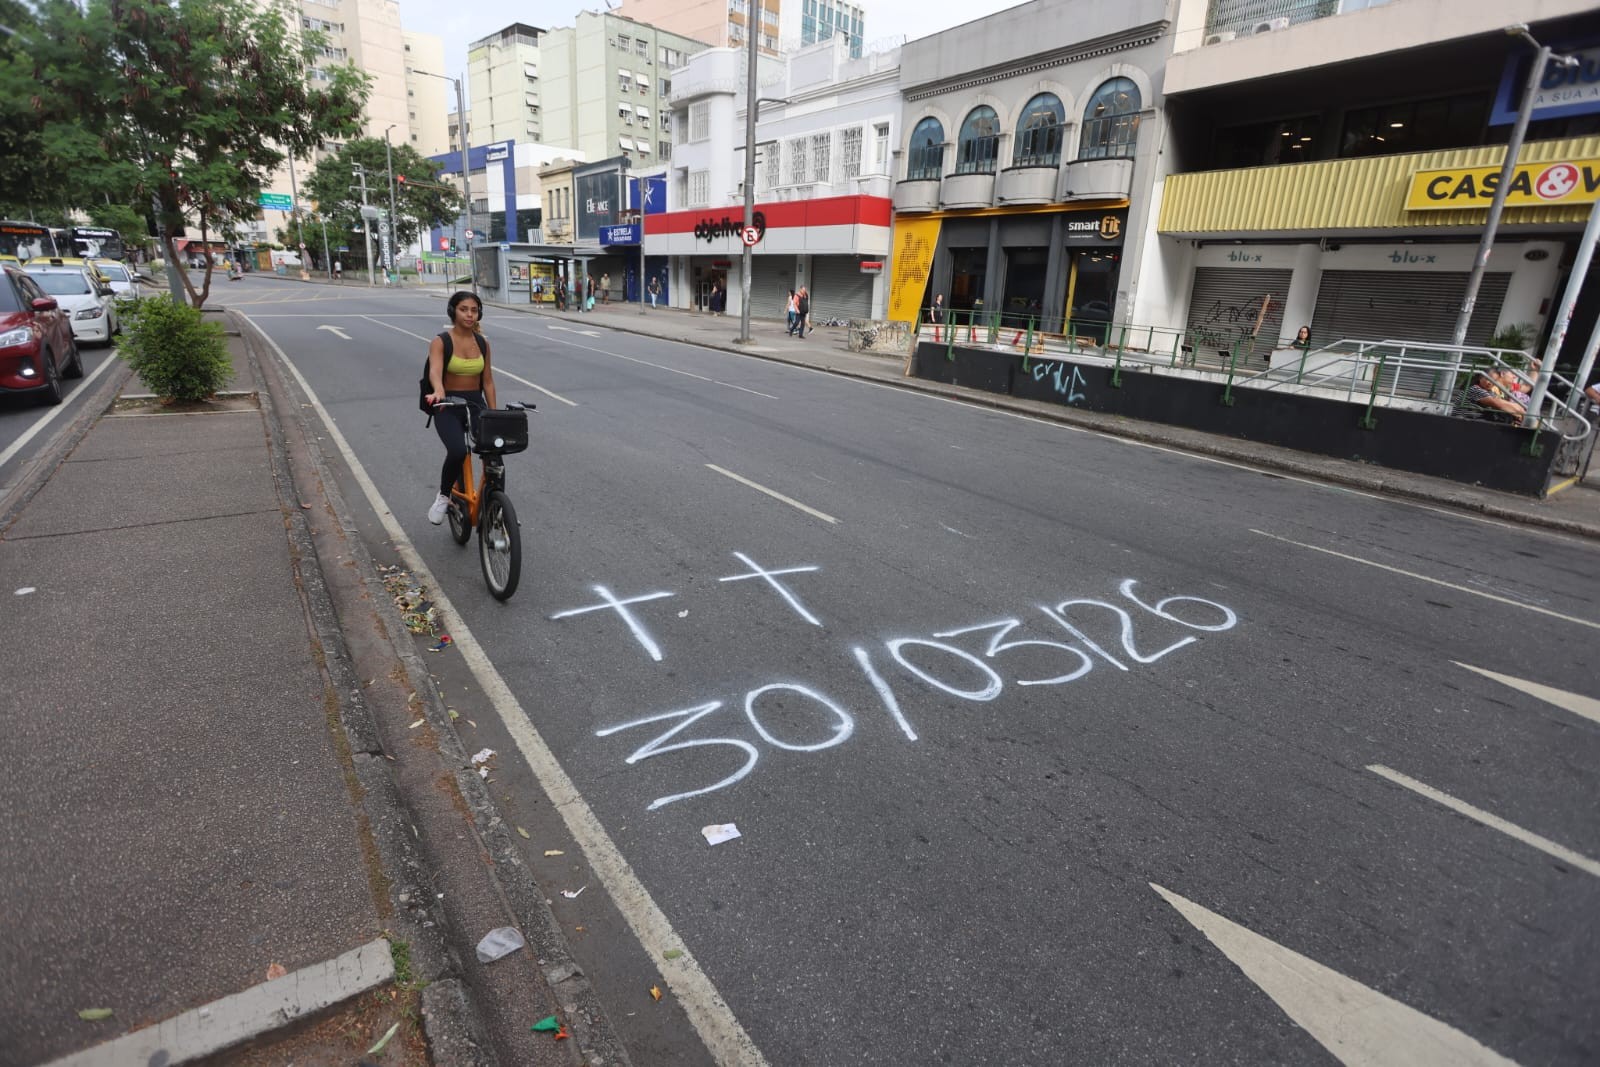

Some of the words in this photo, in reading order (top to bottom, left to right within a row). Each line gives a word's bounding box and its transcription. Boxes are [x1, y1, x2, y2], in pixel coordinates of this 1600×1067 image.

[1551, 89, 1582, 102] SUA
[1068, 220, 1100, 231] smart
[1101, 215, 1121, 233] fit
[613, 227, 632, 236] ESTRELA
[747, 230, 754, 242] E
[595, 578, 1239, 812] 30/03/26
